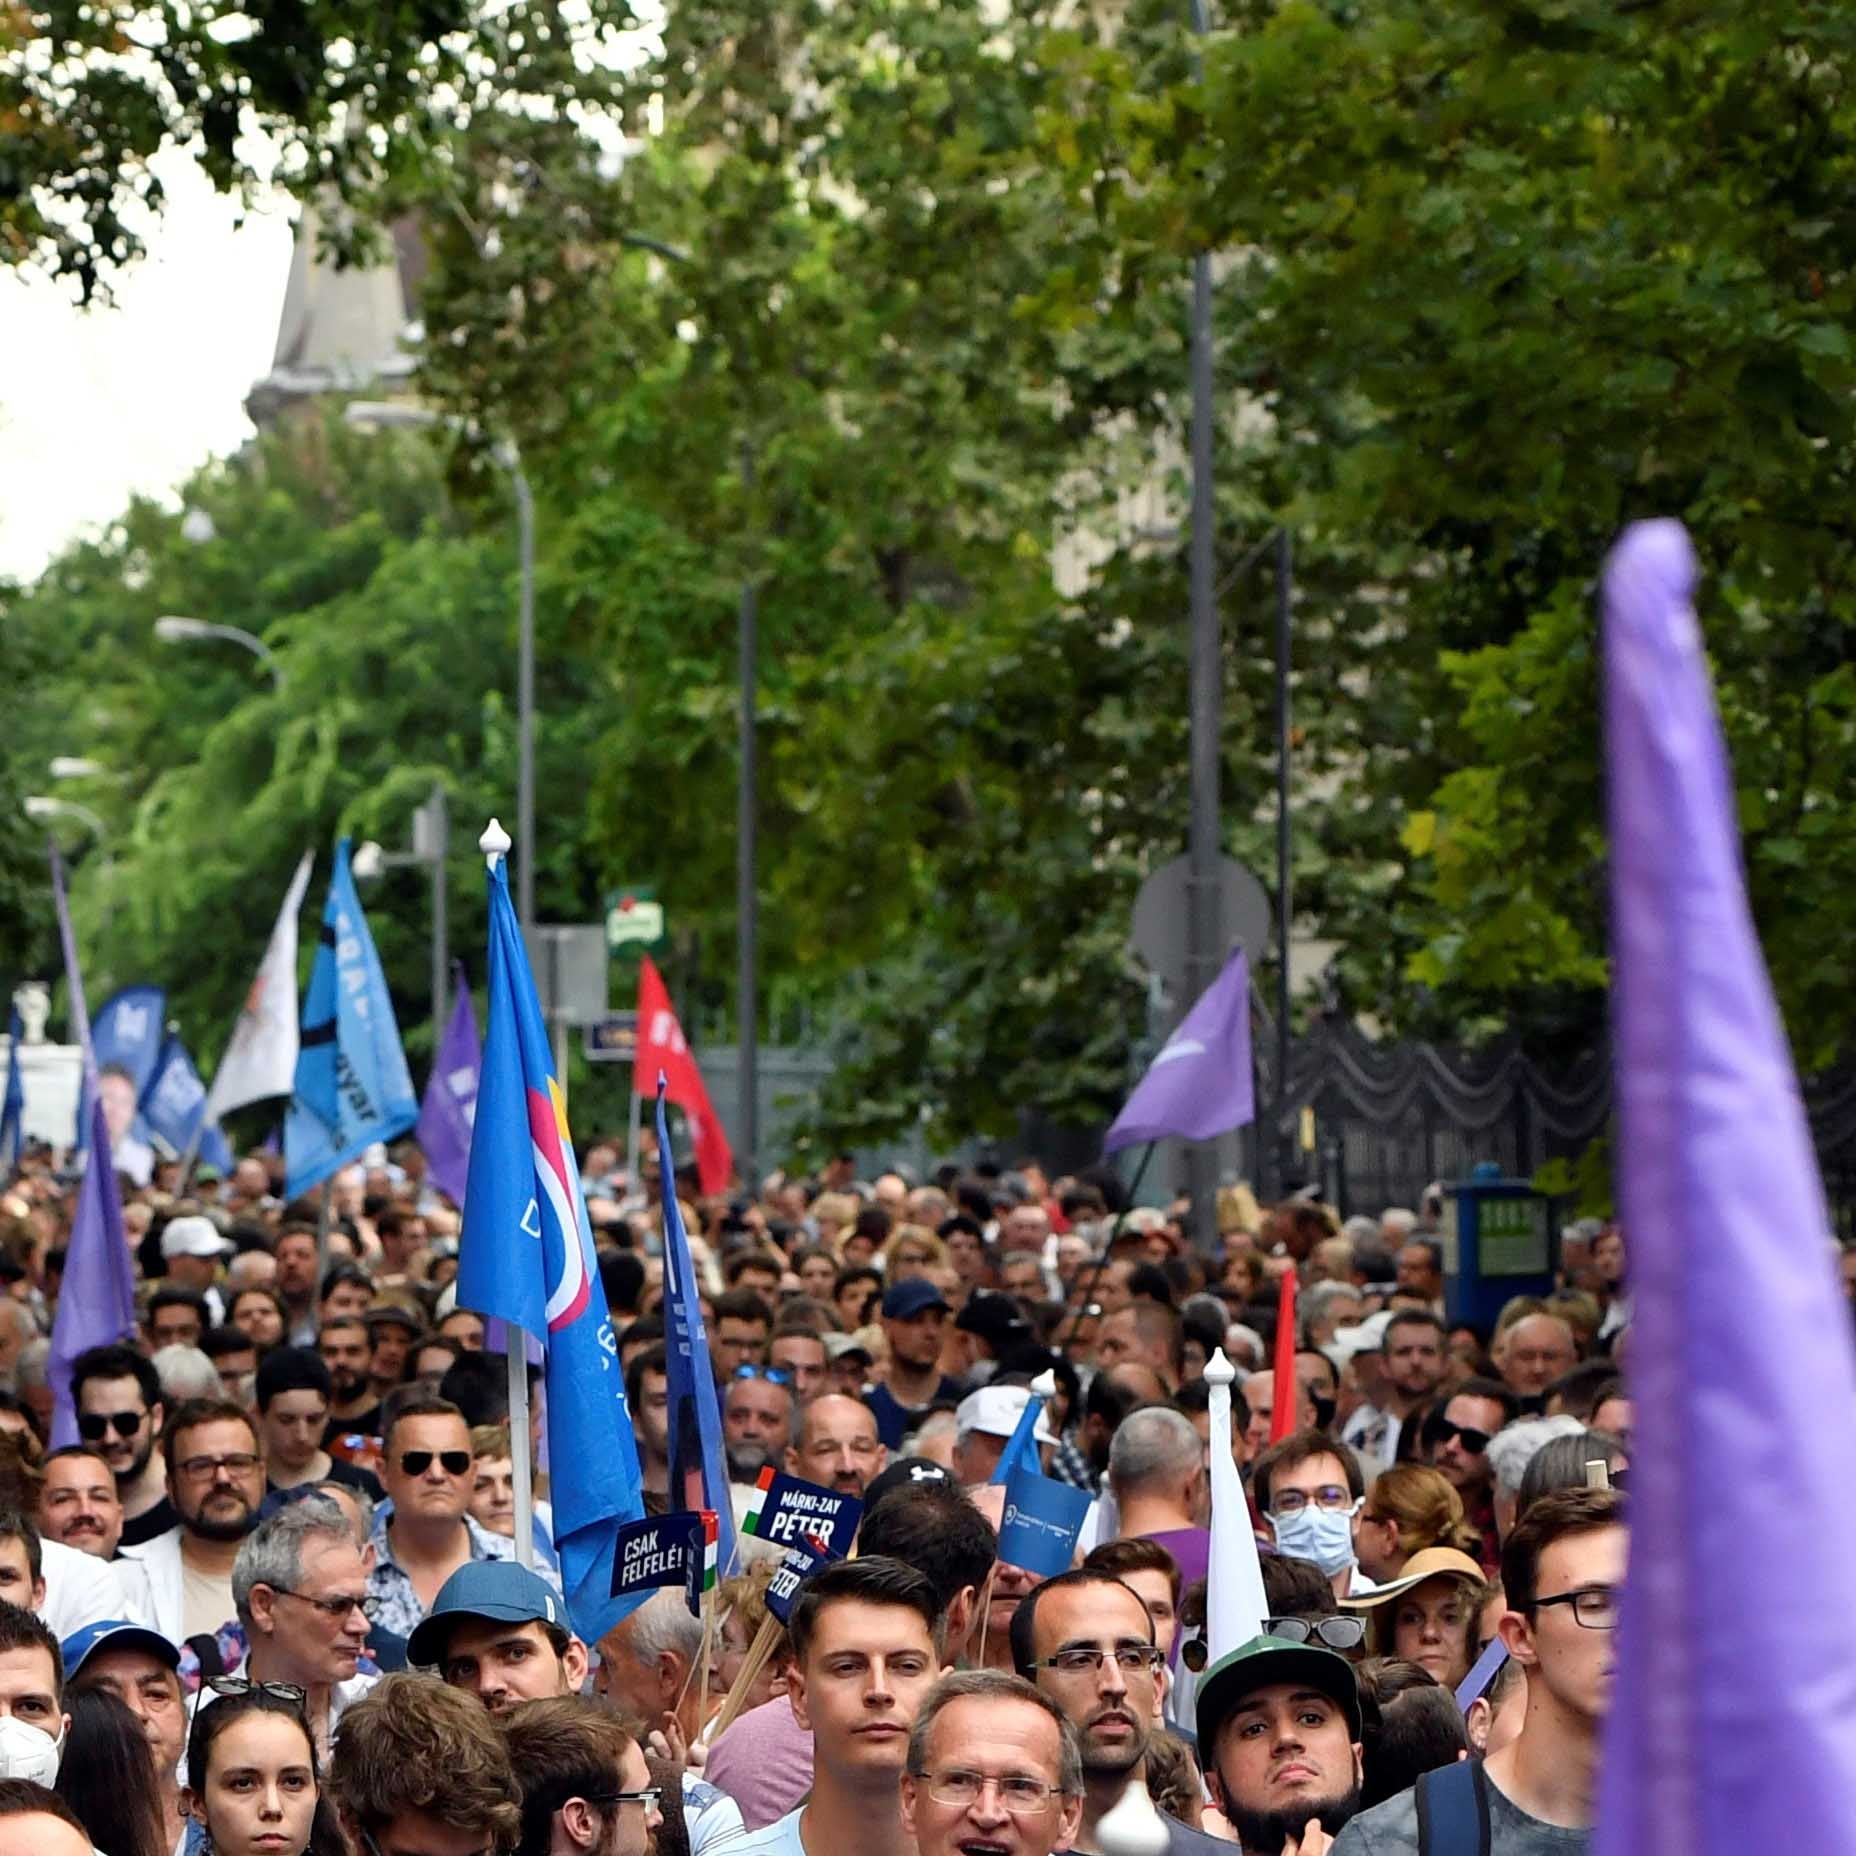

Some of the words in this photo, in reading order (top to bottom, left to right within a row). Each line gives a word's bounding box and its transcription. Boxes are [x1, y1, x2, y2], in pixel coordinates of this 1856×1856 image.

[780, 1489, 842, 1515] MÁRKI-ZAY
[624, 1529, 659, 1562] CSAK
[769, 1509, 835, 1548] PÉTER
[621, 1543, 683, 1587] FELFELÉ!
